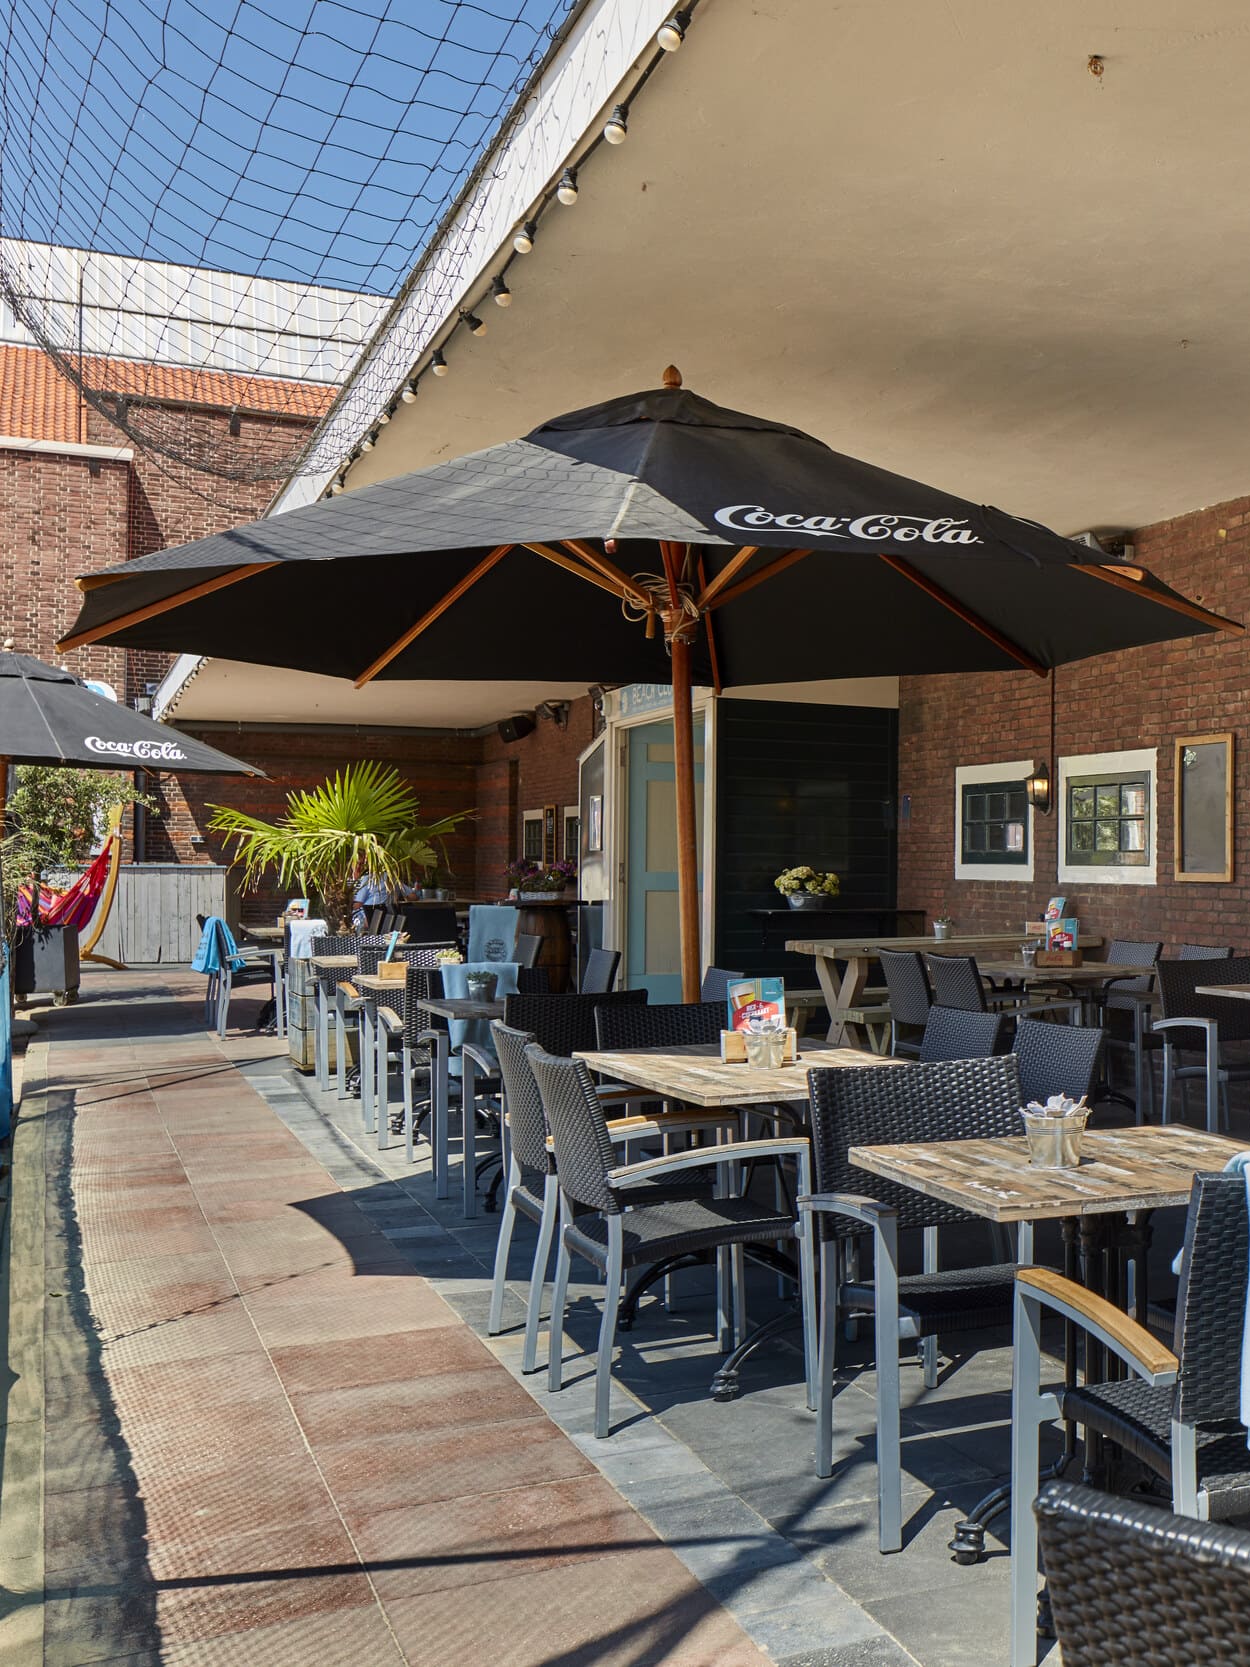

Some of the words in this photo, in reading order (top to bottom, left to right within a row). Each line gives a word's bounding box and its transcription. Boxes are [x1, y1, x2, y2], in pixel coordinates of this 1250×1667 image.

[713, 504, 985, 545] Coca-Cola
[658, 685, 673, 697] CLU
[84, 736, 188, 760] Coca-Cola
